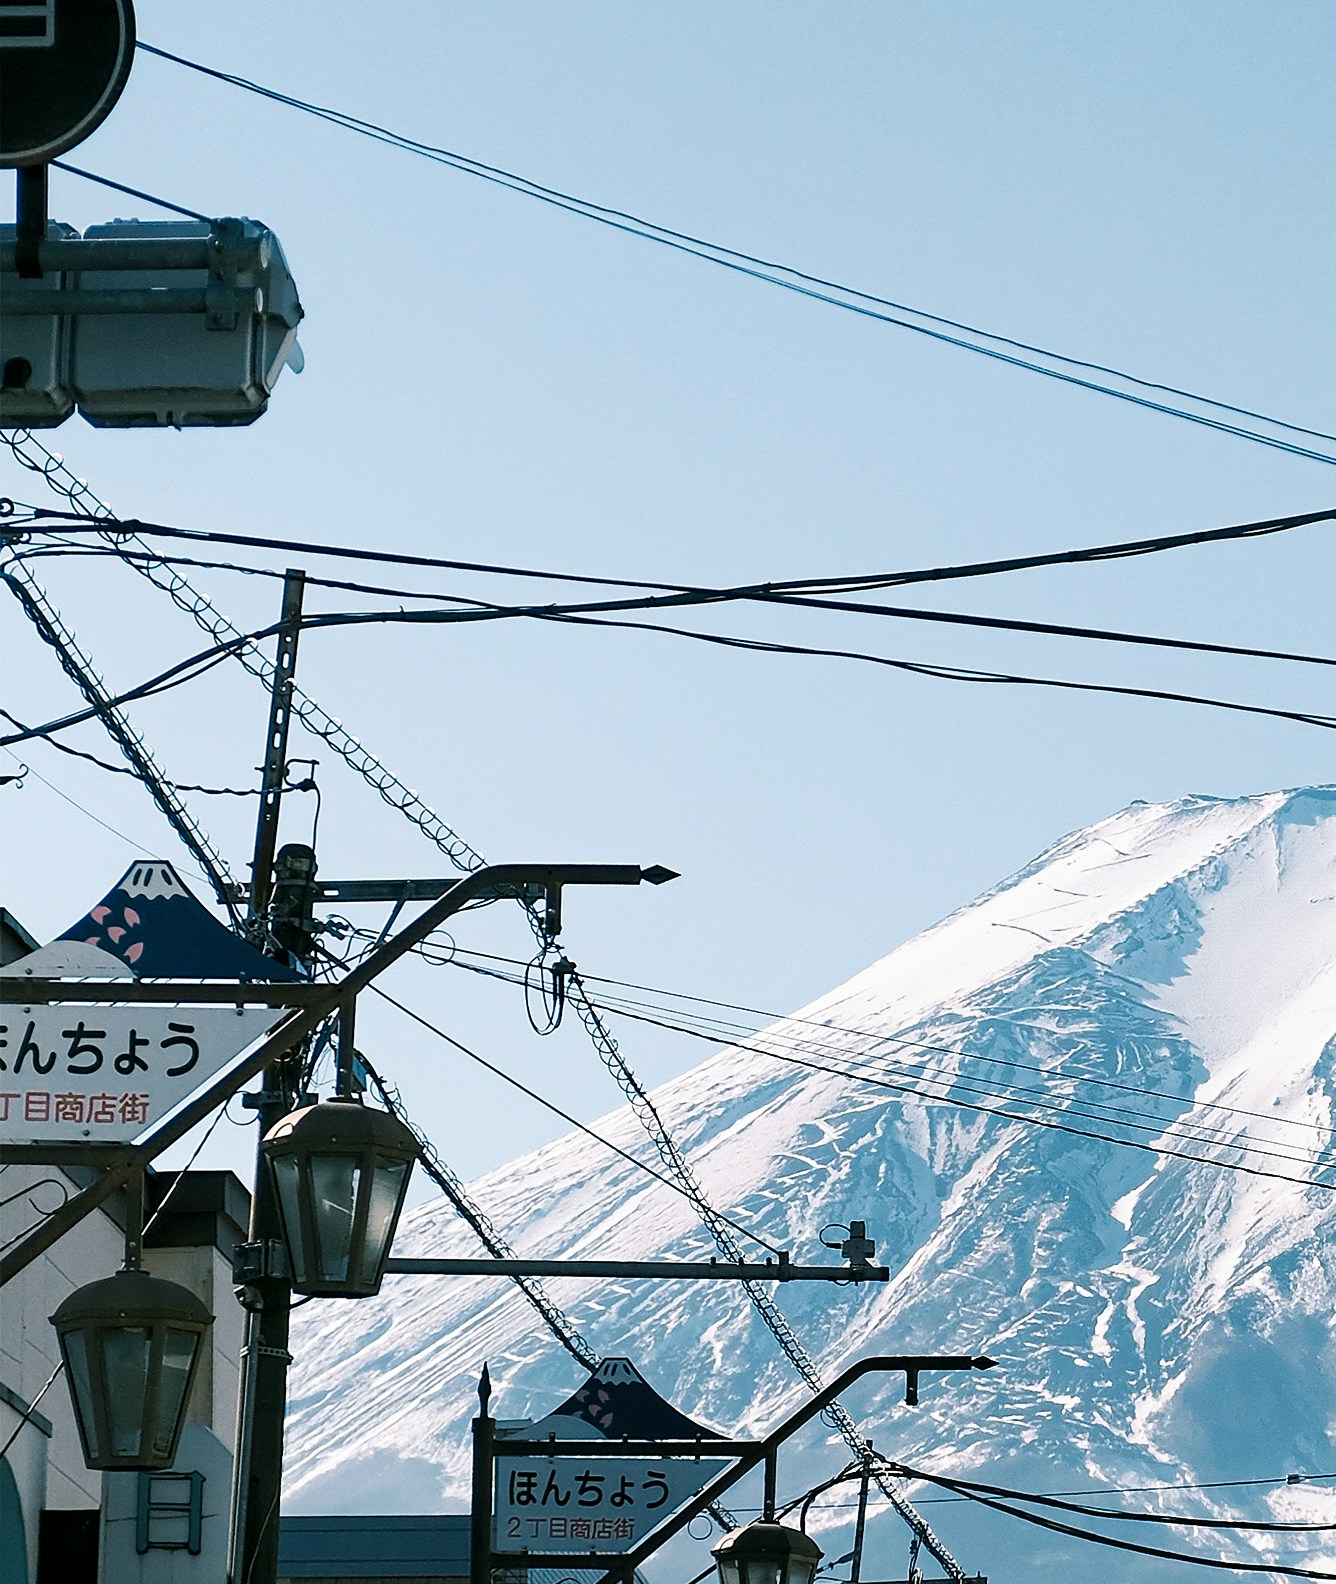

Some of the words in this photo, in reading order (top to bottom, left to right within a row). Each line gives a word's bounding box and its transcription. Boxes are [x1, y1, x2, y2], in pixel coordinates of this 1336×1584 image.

[0, 1020, 199, 1077] んちょう
[508, 1469, 669, 1509] ほんちょう
[506, 1516, 636, 1541] 2丁目商店街
